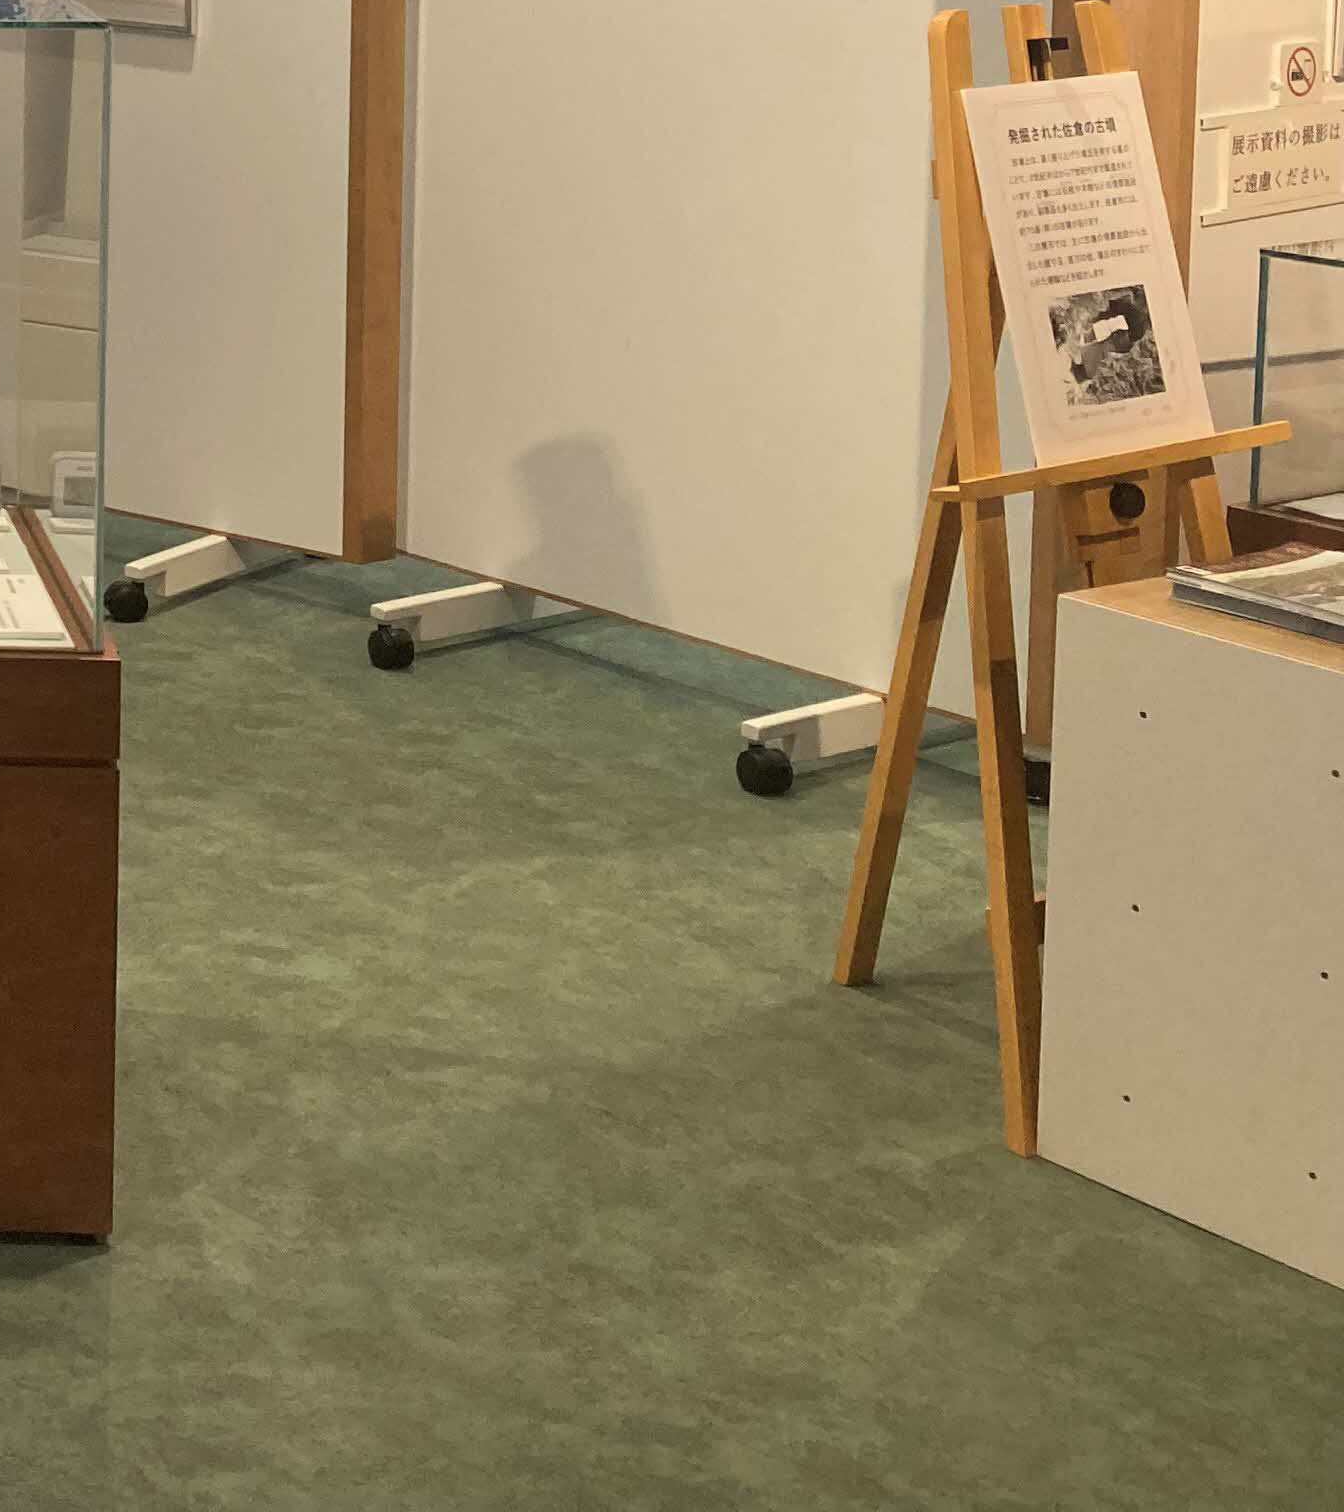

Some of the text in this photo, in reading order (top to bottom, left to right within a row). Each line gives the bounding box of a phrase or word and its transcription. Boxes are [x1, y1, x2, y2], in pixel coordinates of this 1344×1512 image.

[1008, 117, 1118, 145] 発掘された佐倉の古墳
[1231, 122, 1341, 156] 展示資料の撮影は
[1232, 166, 1330, 194] ご遠慮ください。
